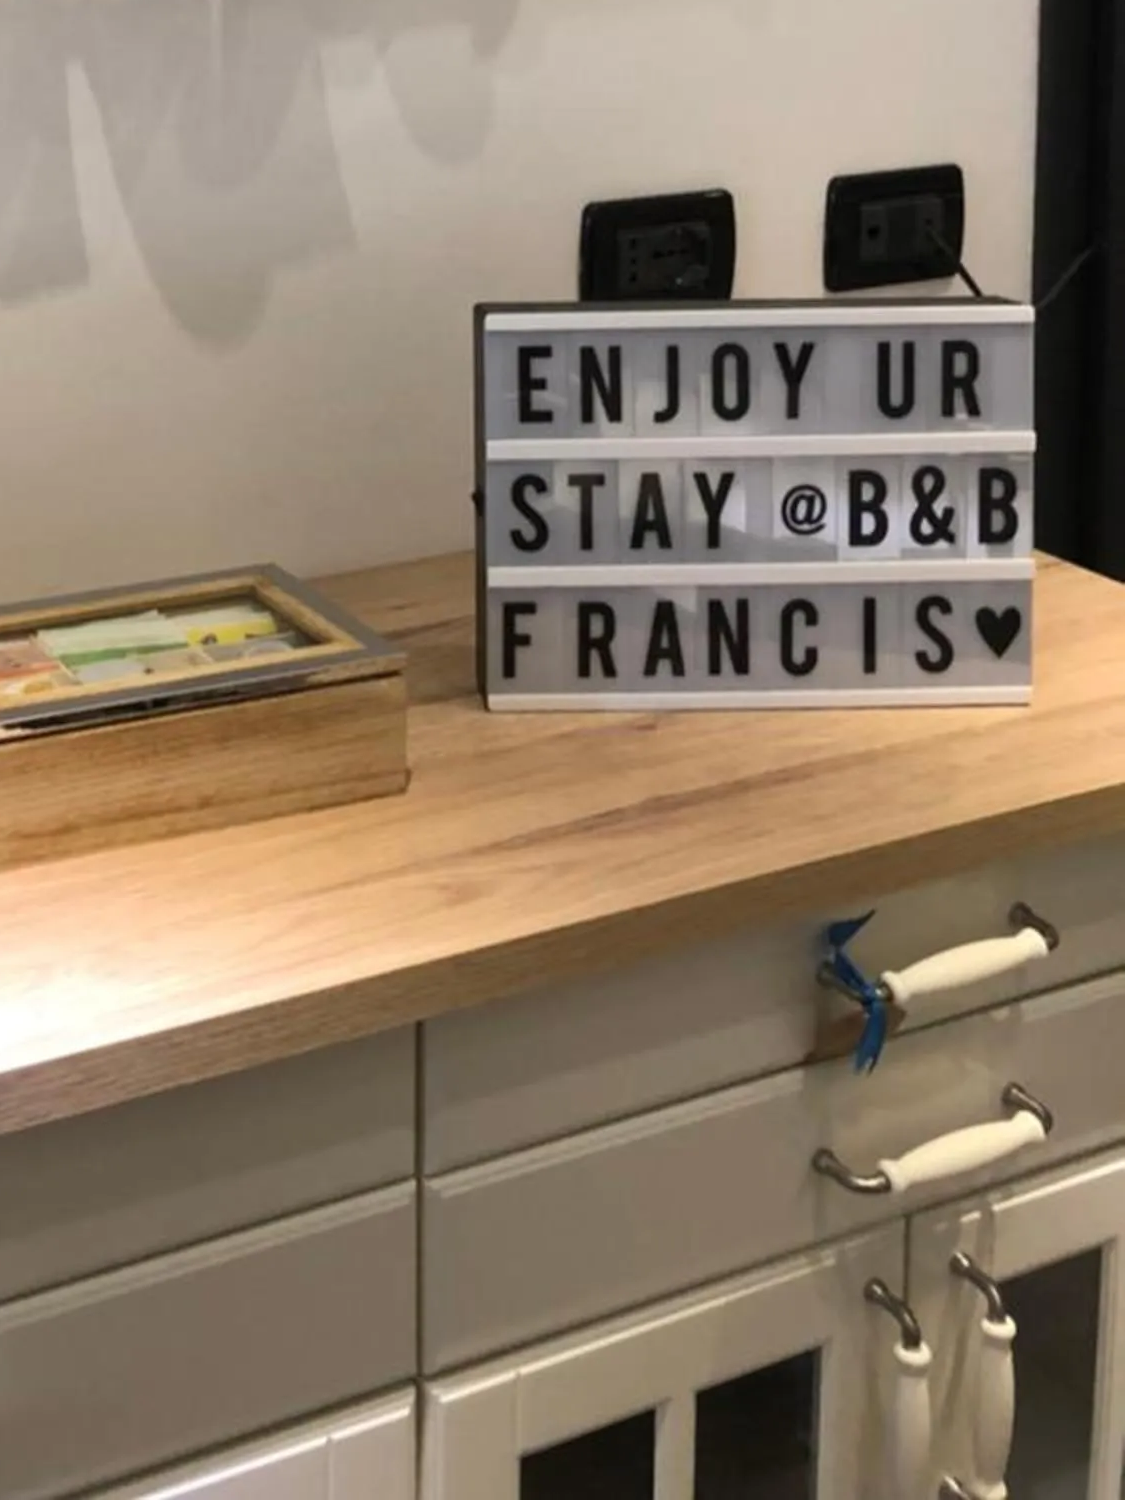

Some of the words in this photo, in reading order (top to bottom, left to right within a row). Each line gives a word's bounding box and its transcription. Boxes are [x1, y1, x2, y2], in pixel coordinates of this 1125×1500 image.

[517, 341, 816, 425] ENJOY
[877, 340, 981, 419] UR
[509, 471, 735, 553] STAY
[502, 595, 955, 680] FRANCIS
